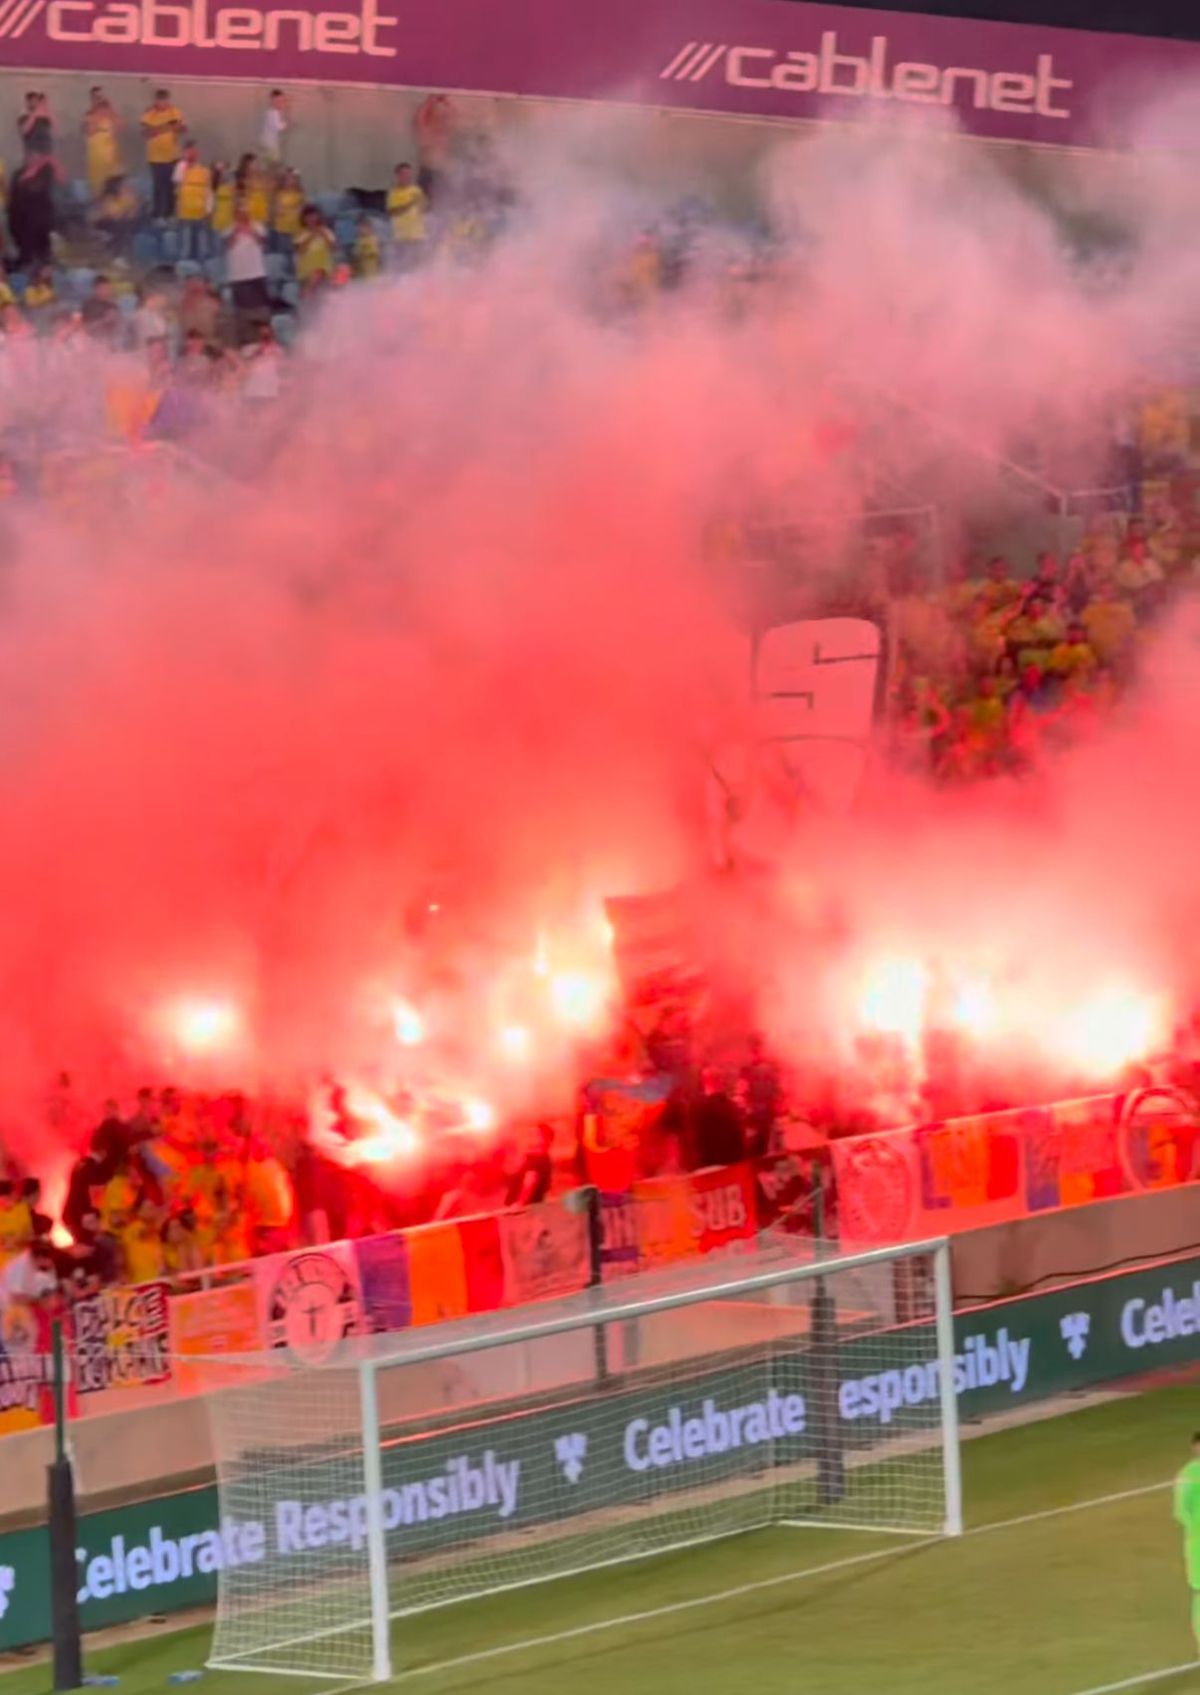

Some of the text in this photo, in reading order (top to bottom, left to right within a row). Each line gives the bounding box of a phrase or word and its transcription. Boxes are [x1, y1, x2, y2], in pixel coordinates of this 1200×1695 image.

[45, 0, 398, 57] cablenet
[724, 31, 1073, 118] cablenet
[623, 1327, 1031, 1471] Celebrate esponsibly
[275, 1450, 520, 1556] Responsibly
